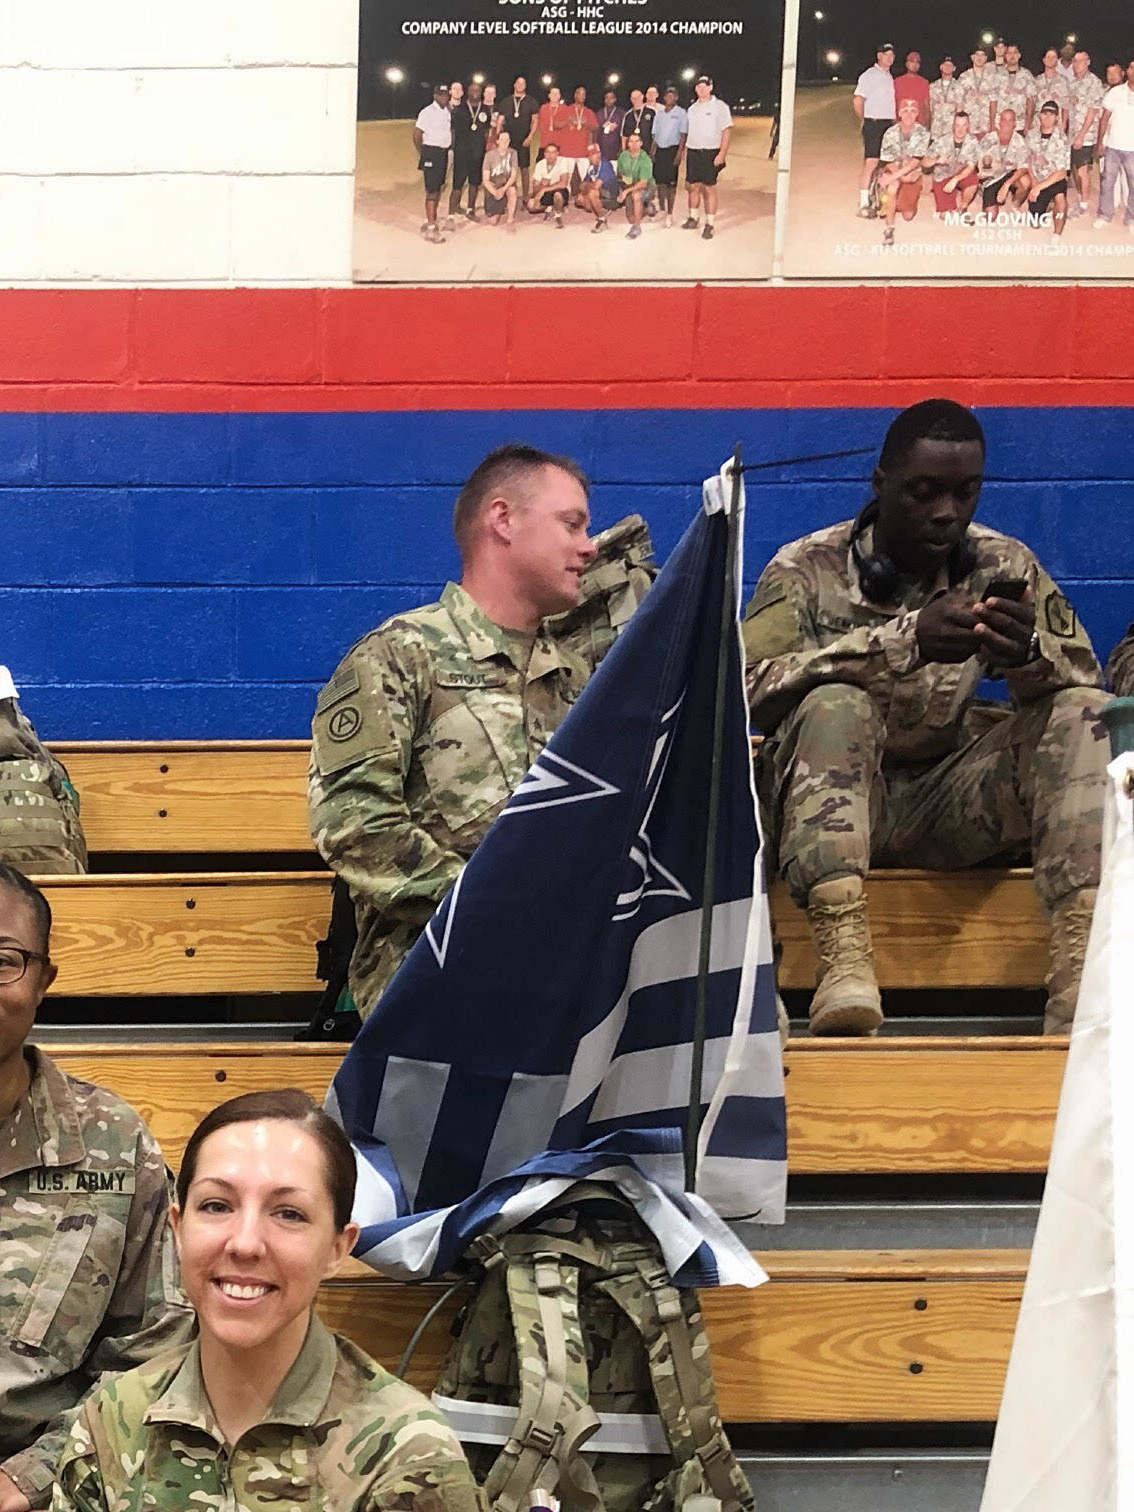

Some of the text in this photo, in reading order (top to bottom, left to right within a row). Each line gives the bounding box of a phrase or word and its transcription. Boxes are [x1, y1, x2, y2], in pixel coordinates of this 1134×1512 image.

[541, 6, 567, 18] ASG
[576, 6, 604, 18] HHC
[401, 21, 743, 35] COMPANY LEVEL SOFTBALL LEAGUE 2014 CHAMPION
[943, 212, 973, 227] MC
[977, 212, 1052, 228] GLOVING
[833, 243, 861, 257] ASG
[36, 1171, 126, 1191] U.S. ARMY
